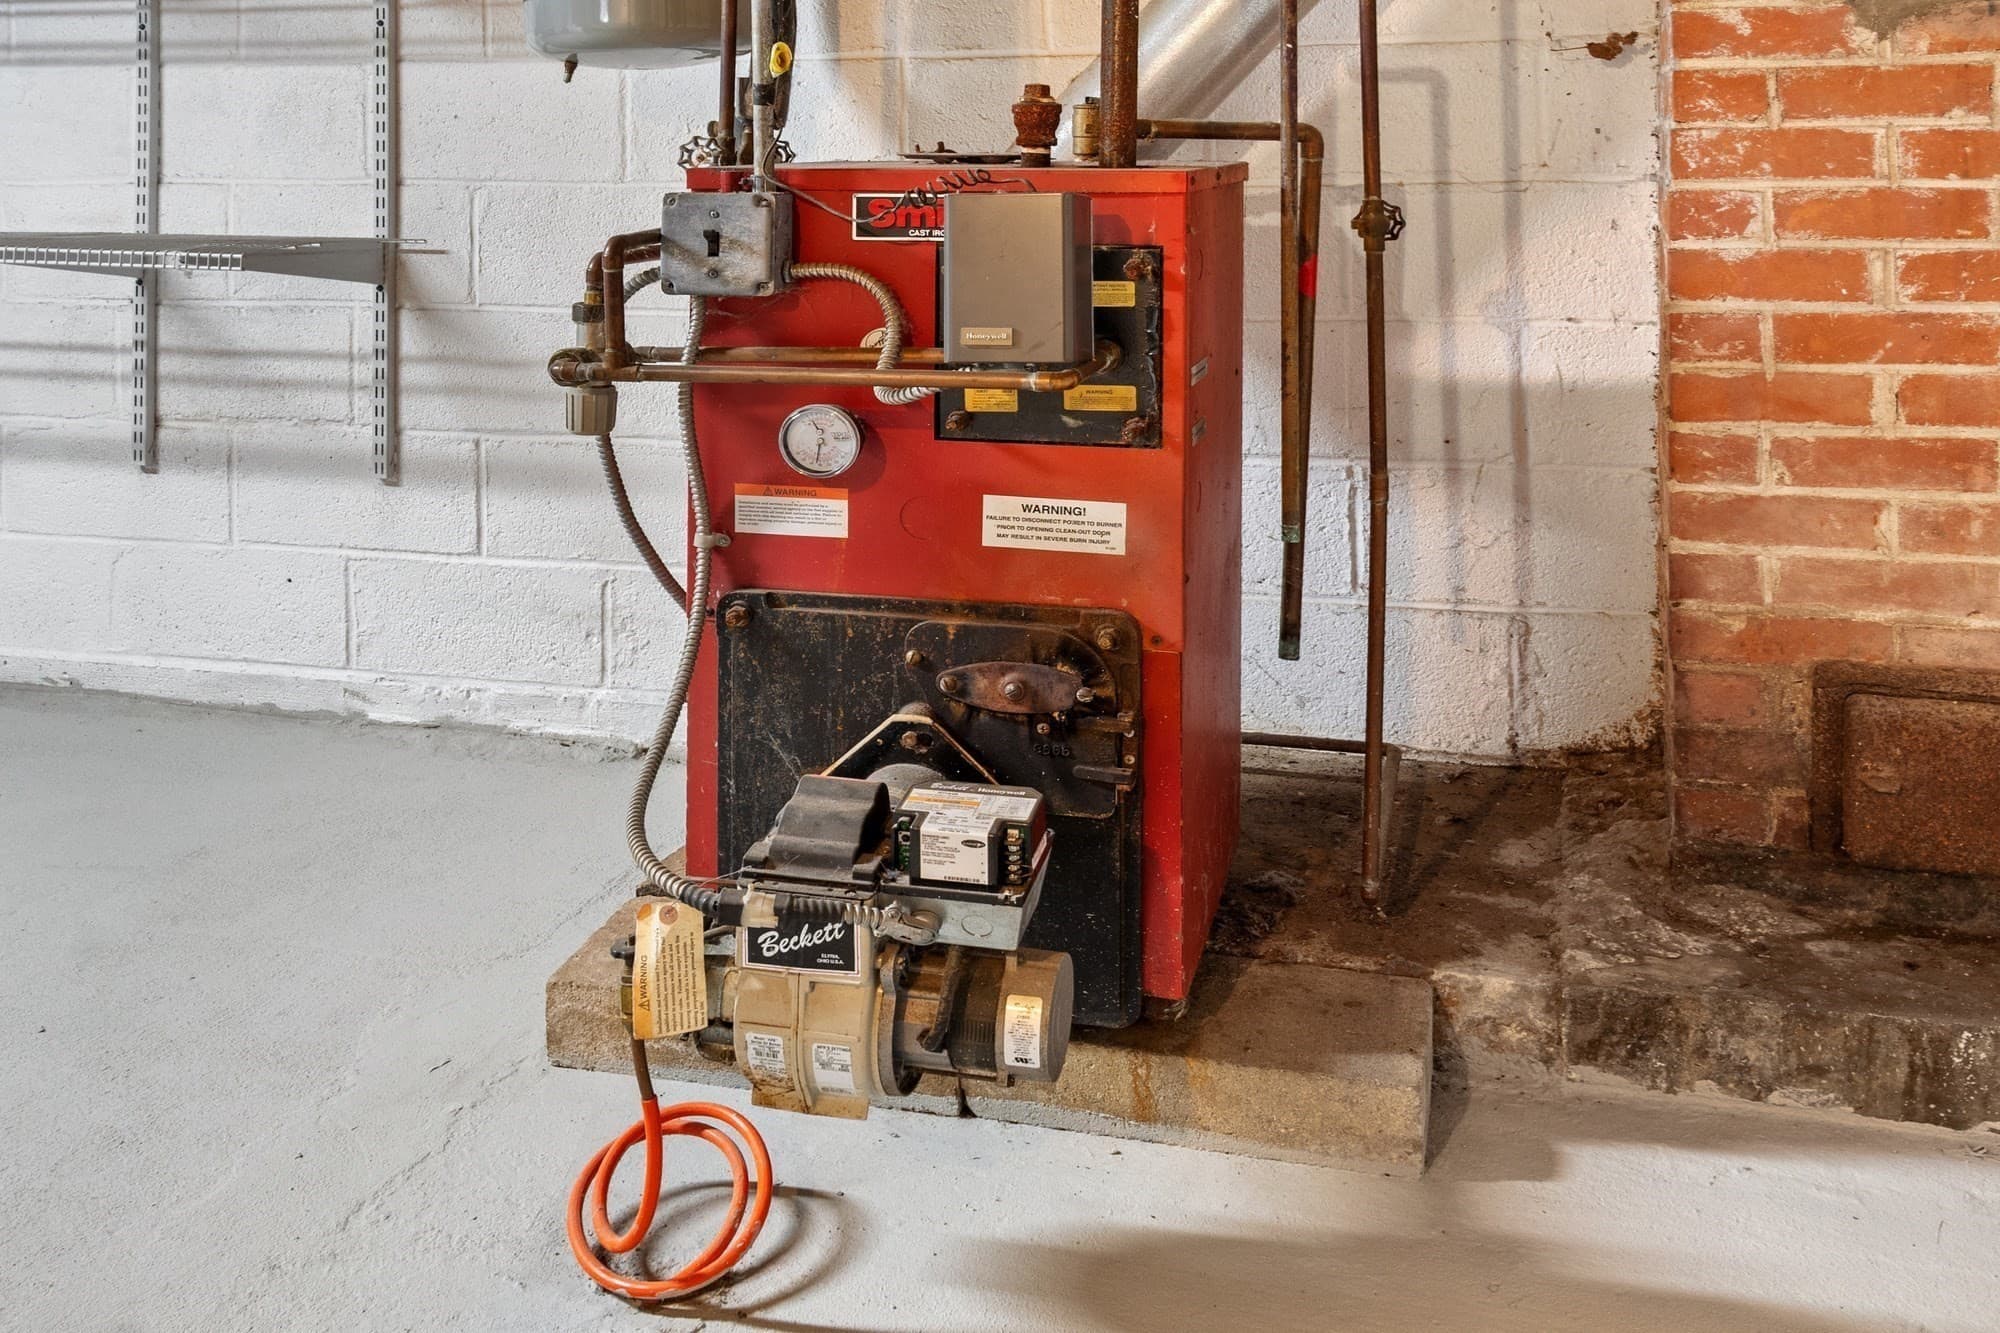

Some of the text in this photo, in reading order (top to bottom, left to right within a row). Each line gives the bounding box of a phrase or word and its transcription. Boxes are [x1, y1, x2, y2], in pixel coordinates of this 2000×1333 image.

[966, 332, 1007, 341] Honeywell
[775, 488, 817, 497] WARNING
[1022, 503, 1086, 516] WARNING!
[978, 787, 1026, 796] Honeywell
[757, 922, 845, 957] Beckett
[640, 955, 648, 999] WARNING
